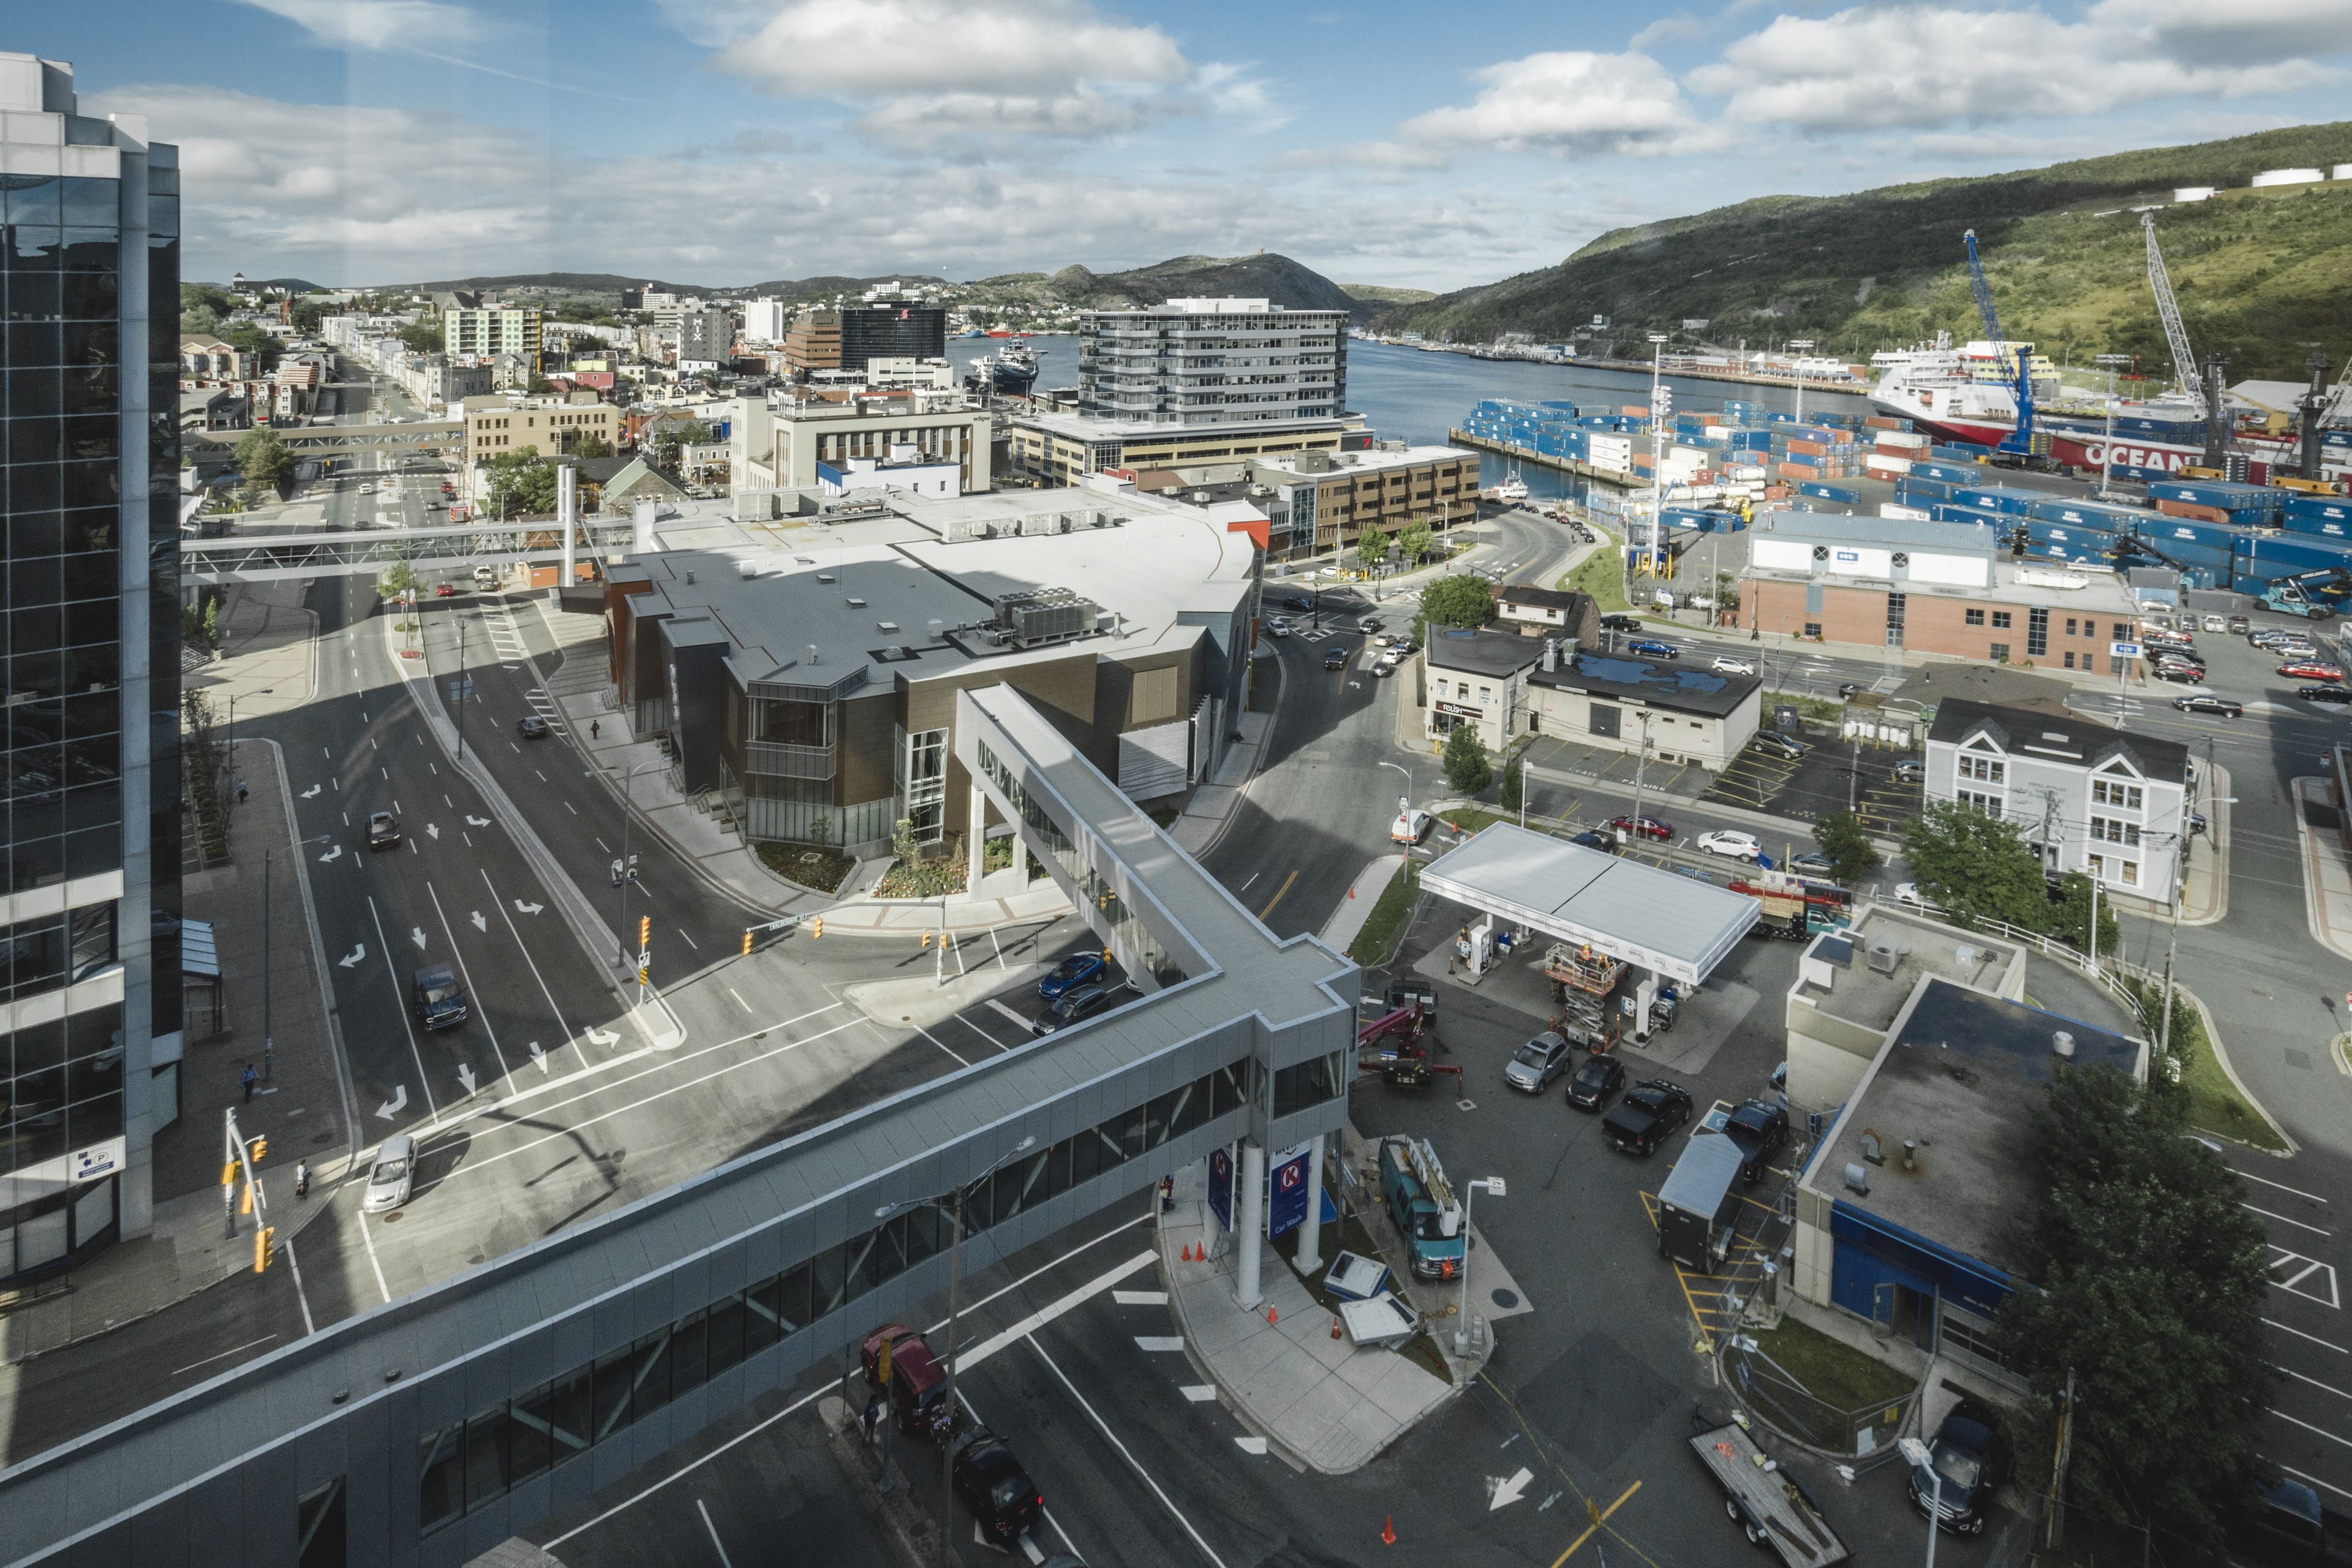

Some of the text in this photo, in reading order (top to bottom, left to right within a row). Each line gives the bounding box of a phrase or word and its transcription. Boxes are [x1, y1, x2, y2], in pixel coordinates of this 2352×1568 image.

[693, 318, 702, 341] MIX
[1622, 778, 1666, 791] PAKING
[1275, 1215, 1302, 1234] Car Wash
